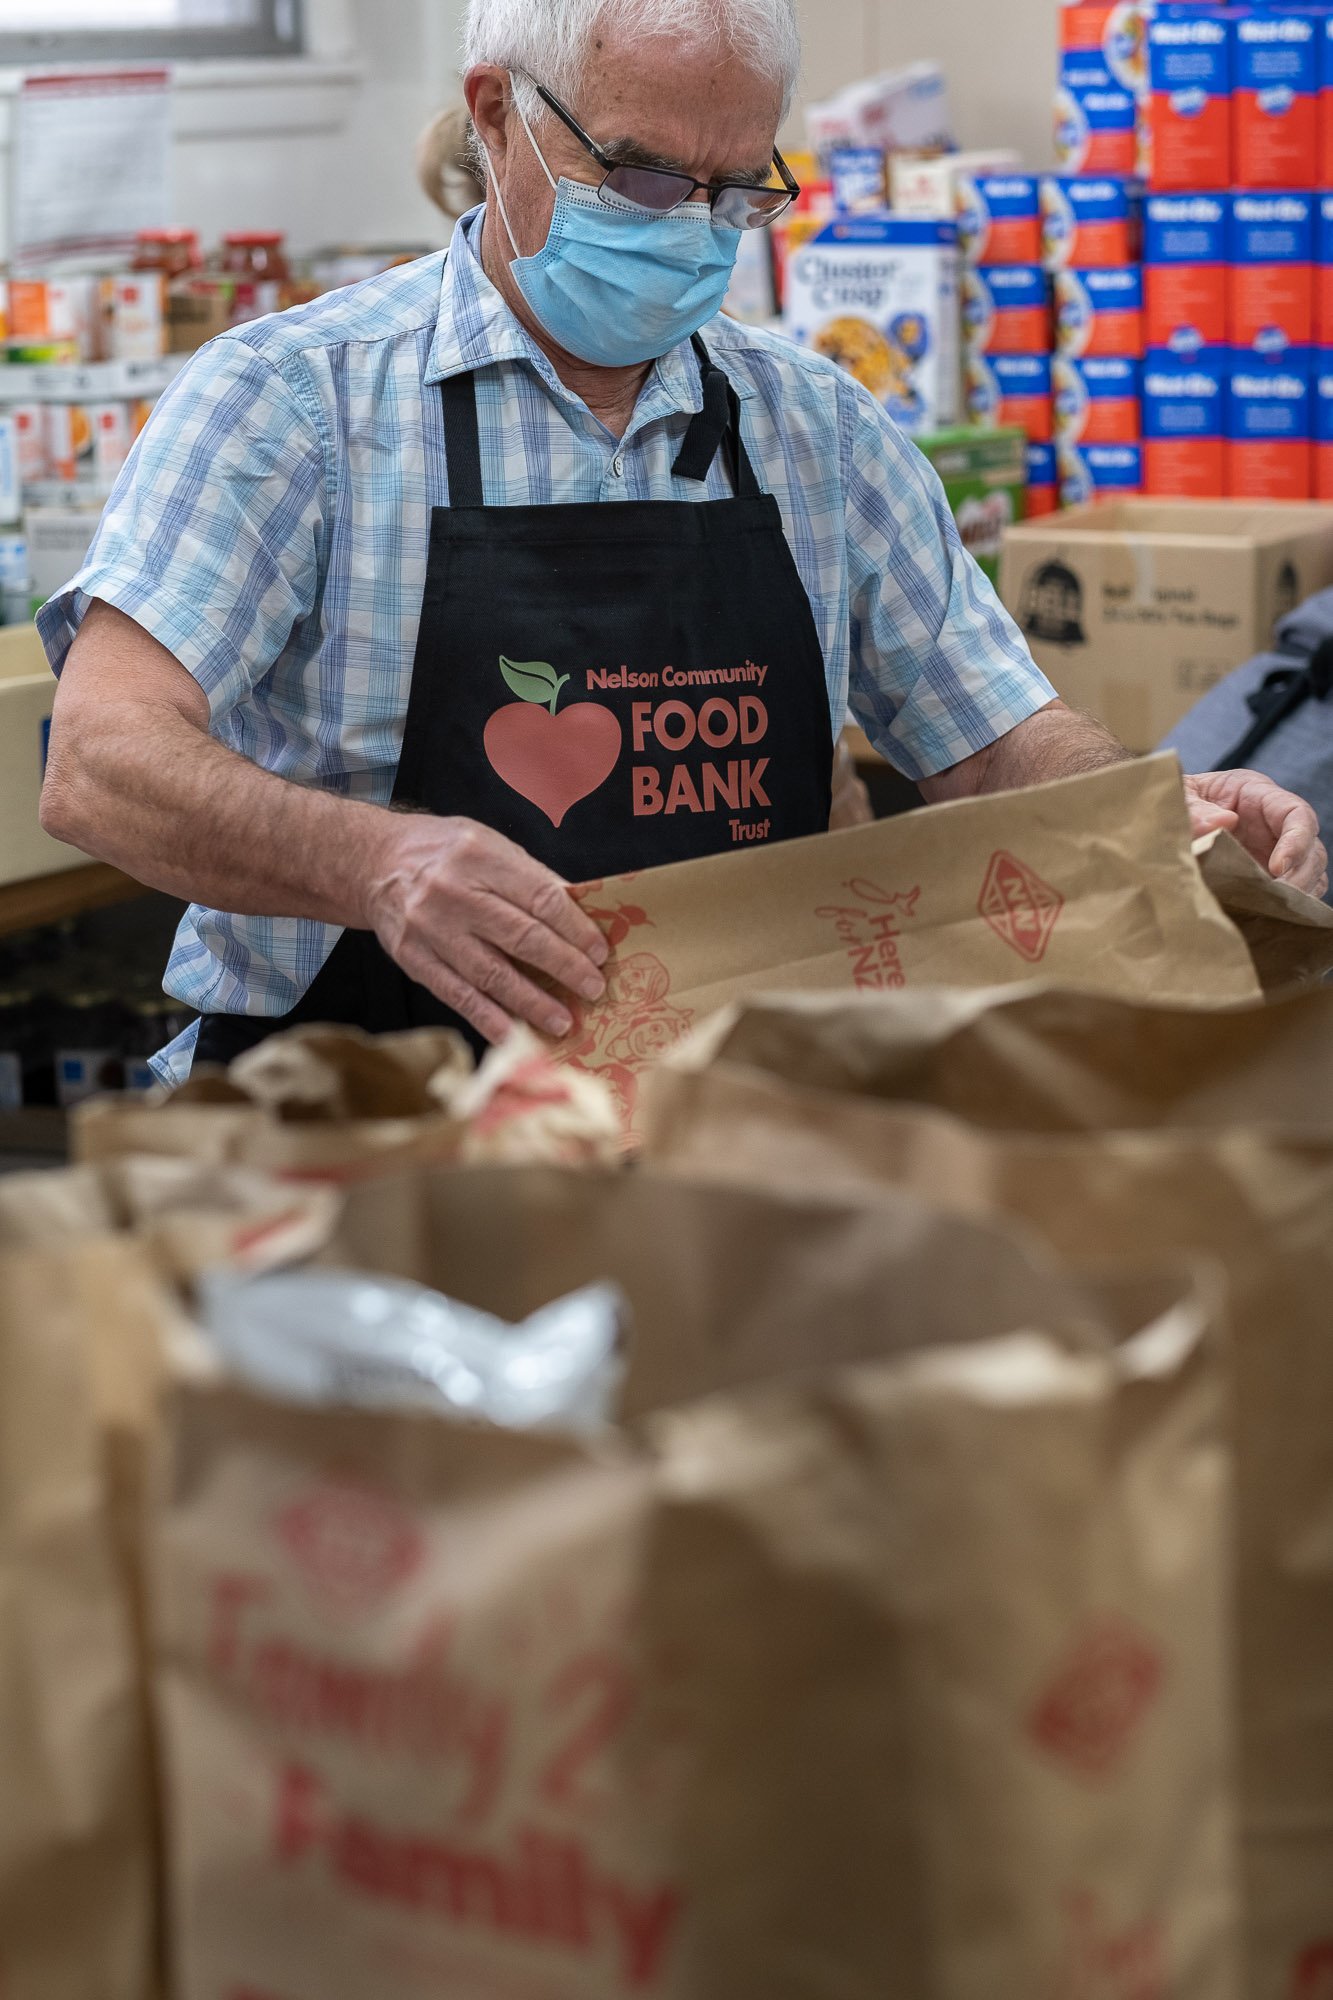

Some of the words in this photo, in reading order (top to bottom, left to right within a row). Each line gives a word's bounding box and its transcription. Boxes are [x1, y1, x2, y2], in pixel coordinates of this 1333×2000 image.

[586, 665, 659, 690] Nelson
[662, 659, 768, 687] Community
[632, 695, 769, 752] FOOD
[632, 757, 772, 816] BANK
[729, 818, 771, 842] Trust
[869, 913, 906, 990] Here
